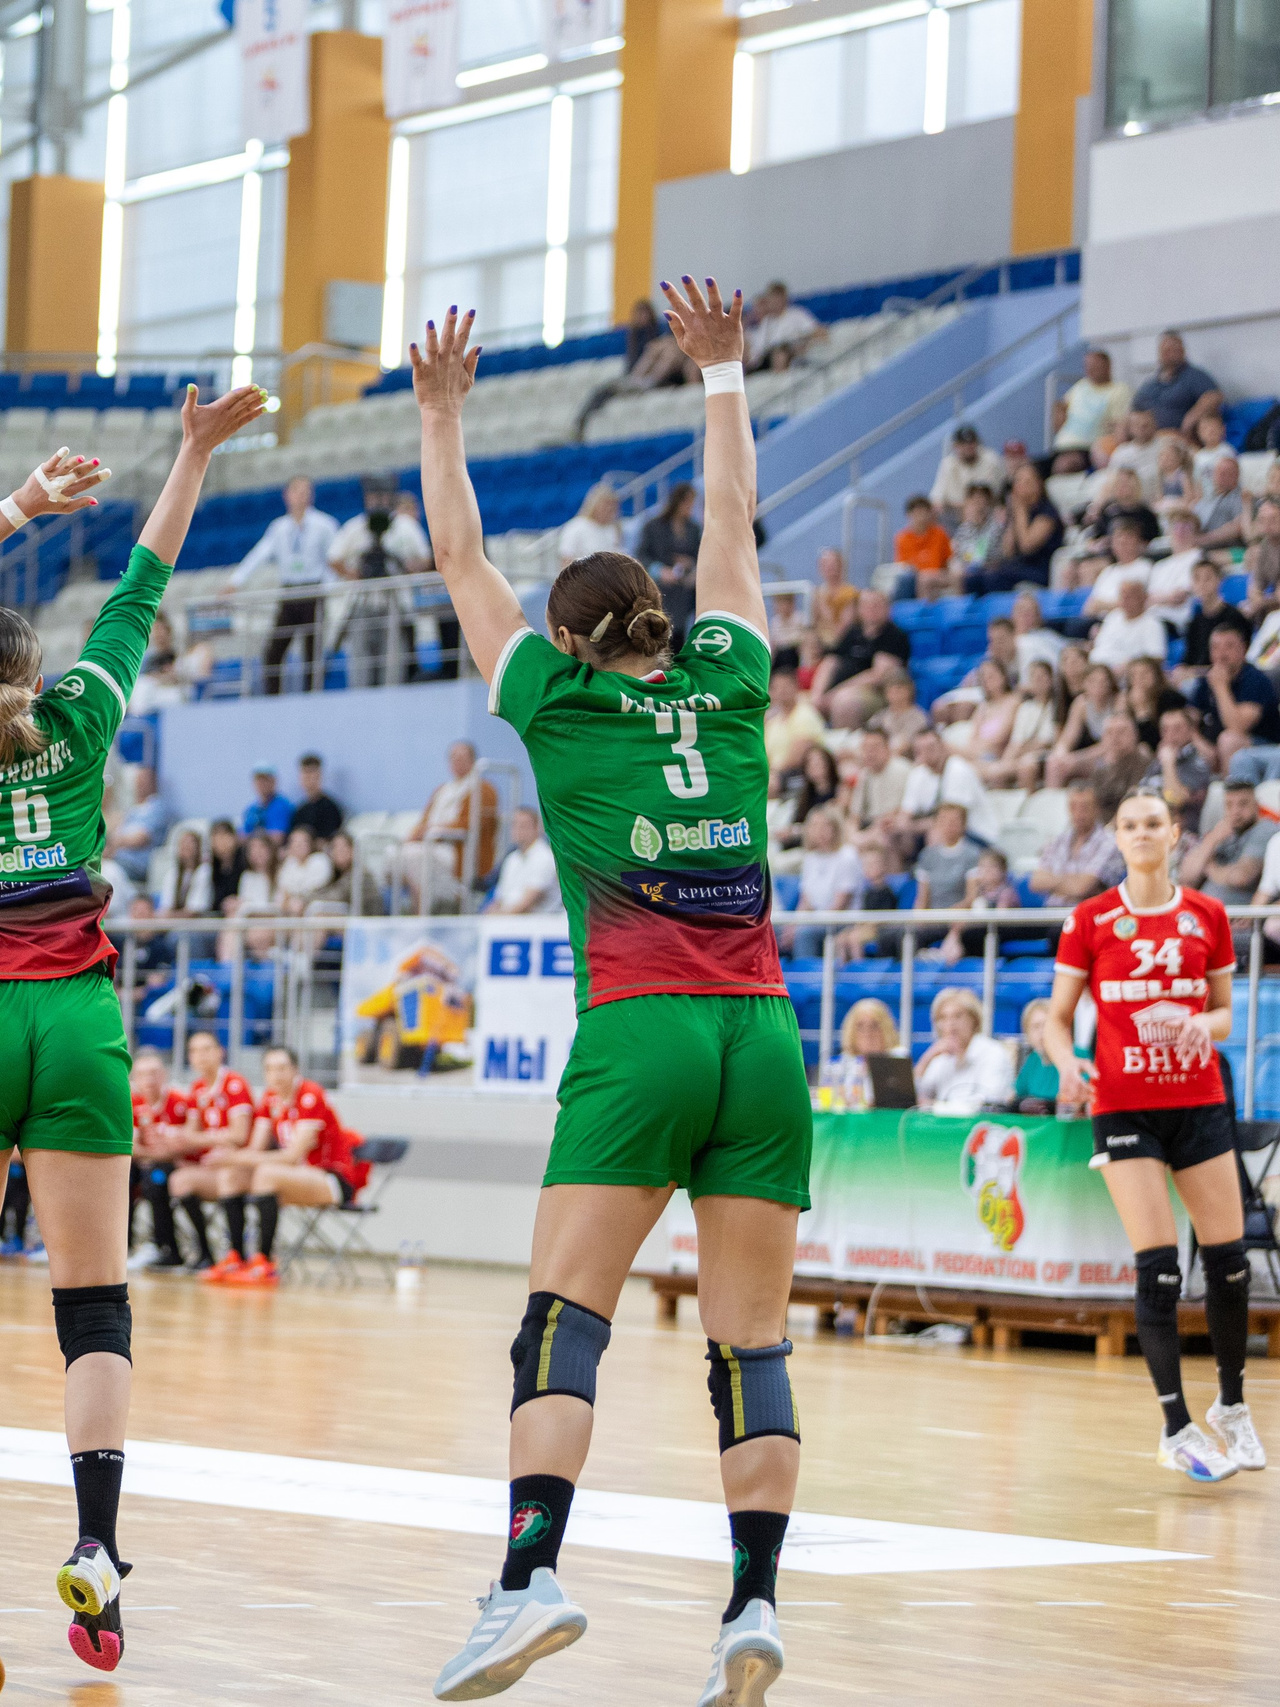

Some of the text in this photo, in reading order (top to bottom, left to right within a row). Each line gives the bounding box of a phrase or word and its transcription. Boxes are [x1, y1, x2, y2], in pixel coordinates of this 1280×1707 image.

[655, 708, 710, 799] 3
[667, 819, 750, 850] BelFert
[1129, 938, 1183, 978] 34
